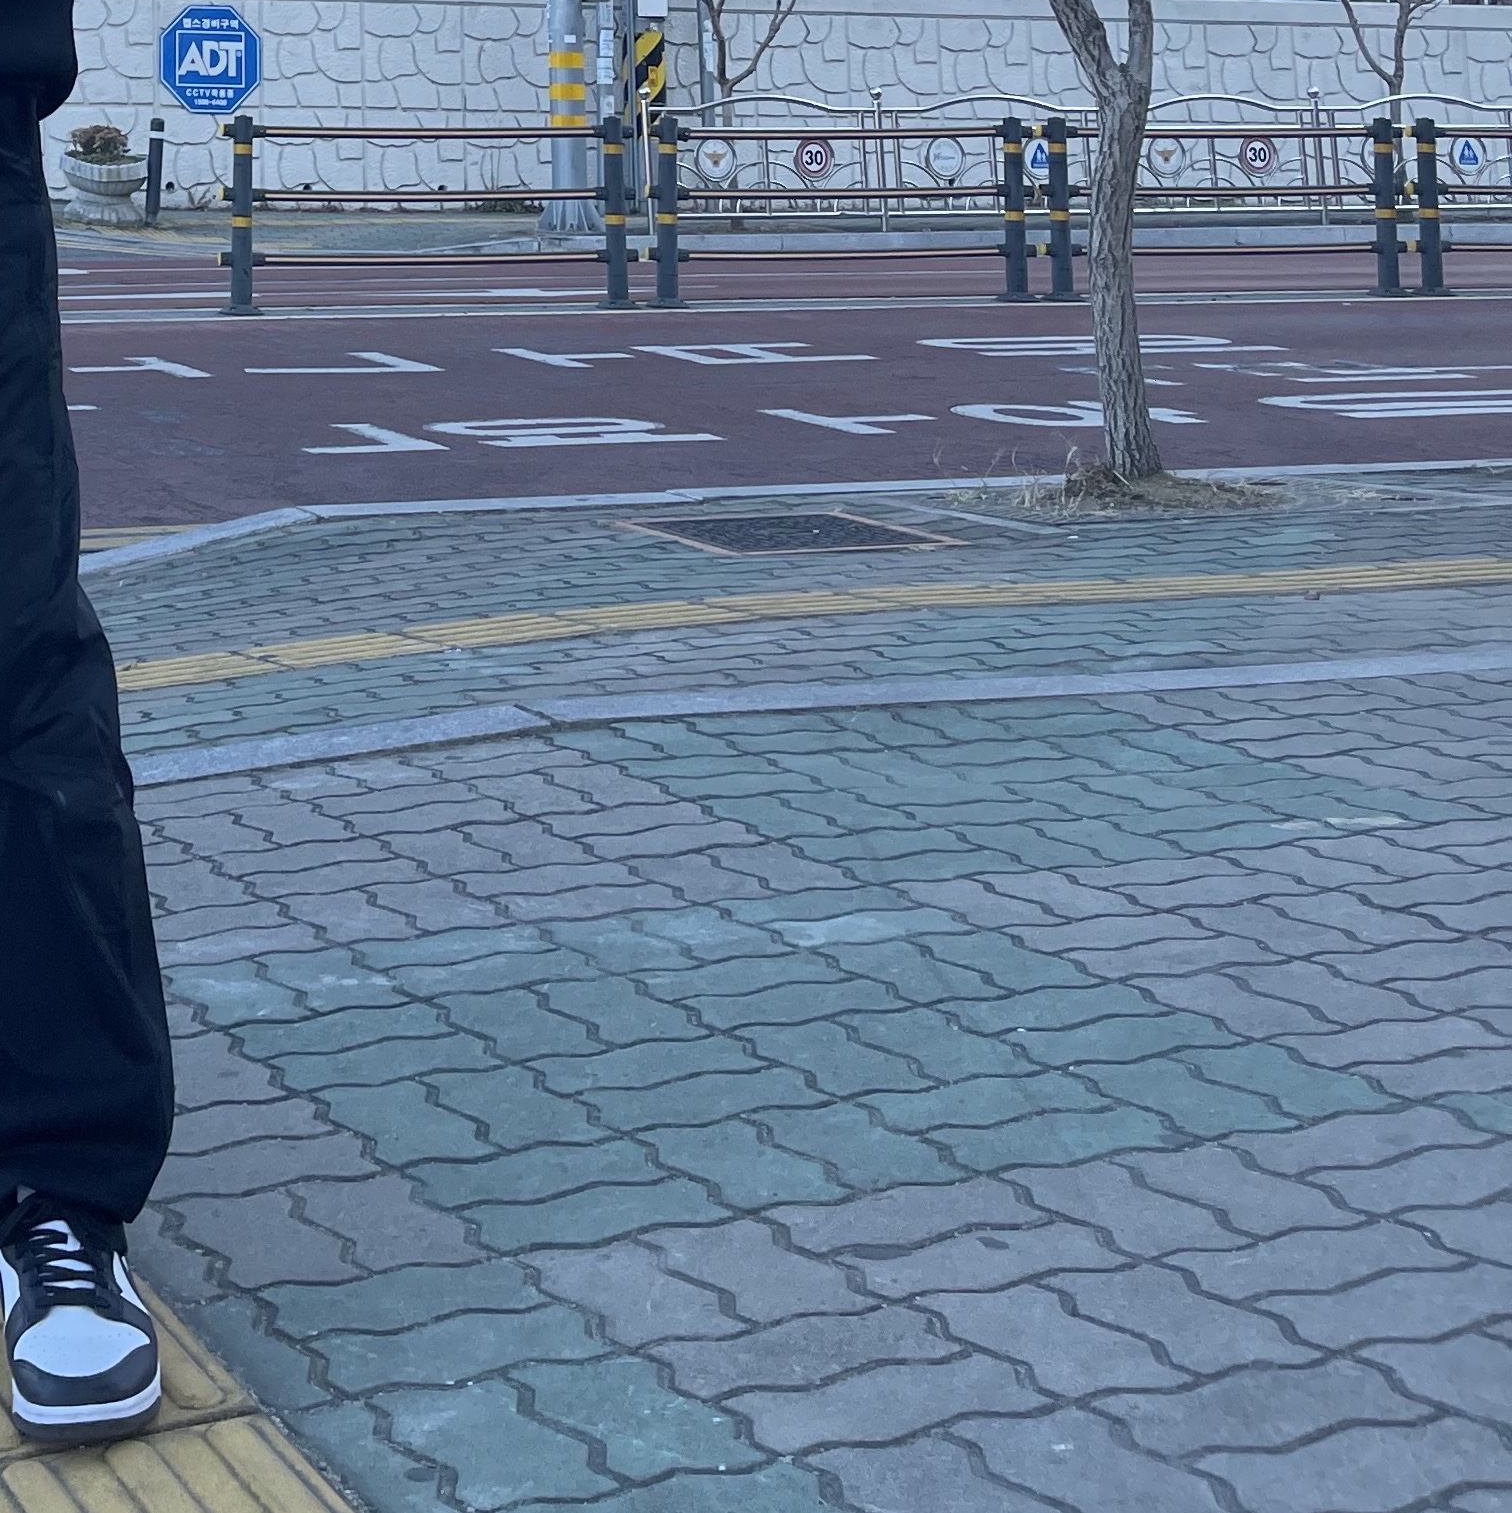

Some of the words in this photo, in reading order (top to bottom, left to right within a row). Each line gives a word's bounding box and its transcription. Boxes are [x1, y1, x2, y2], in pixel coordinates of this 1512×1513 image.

[178, 40, 244, 77] ADT
[804, 150, 824, 166] 30
[1248, 146, 1267, 163] 30
